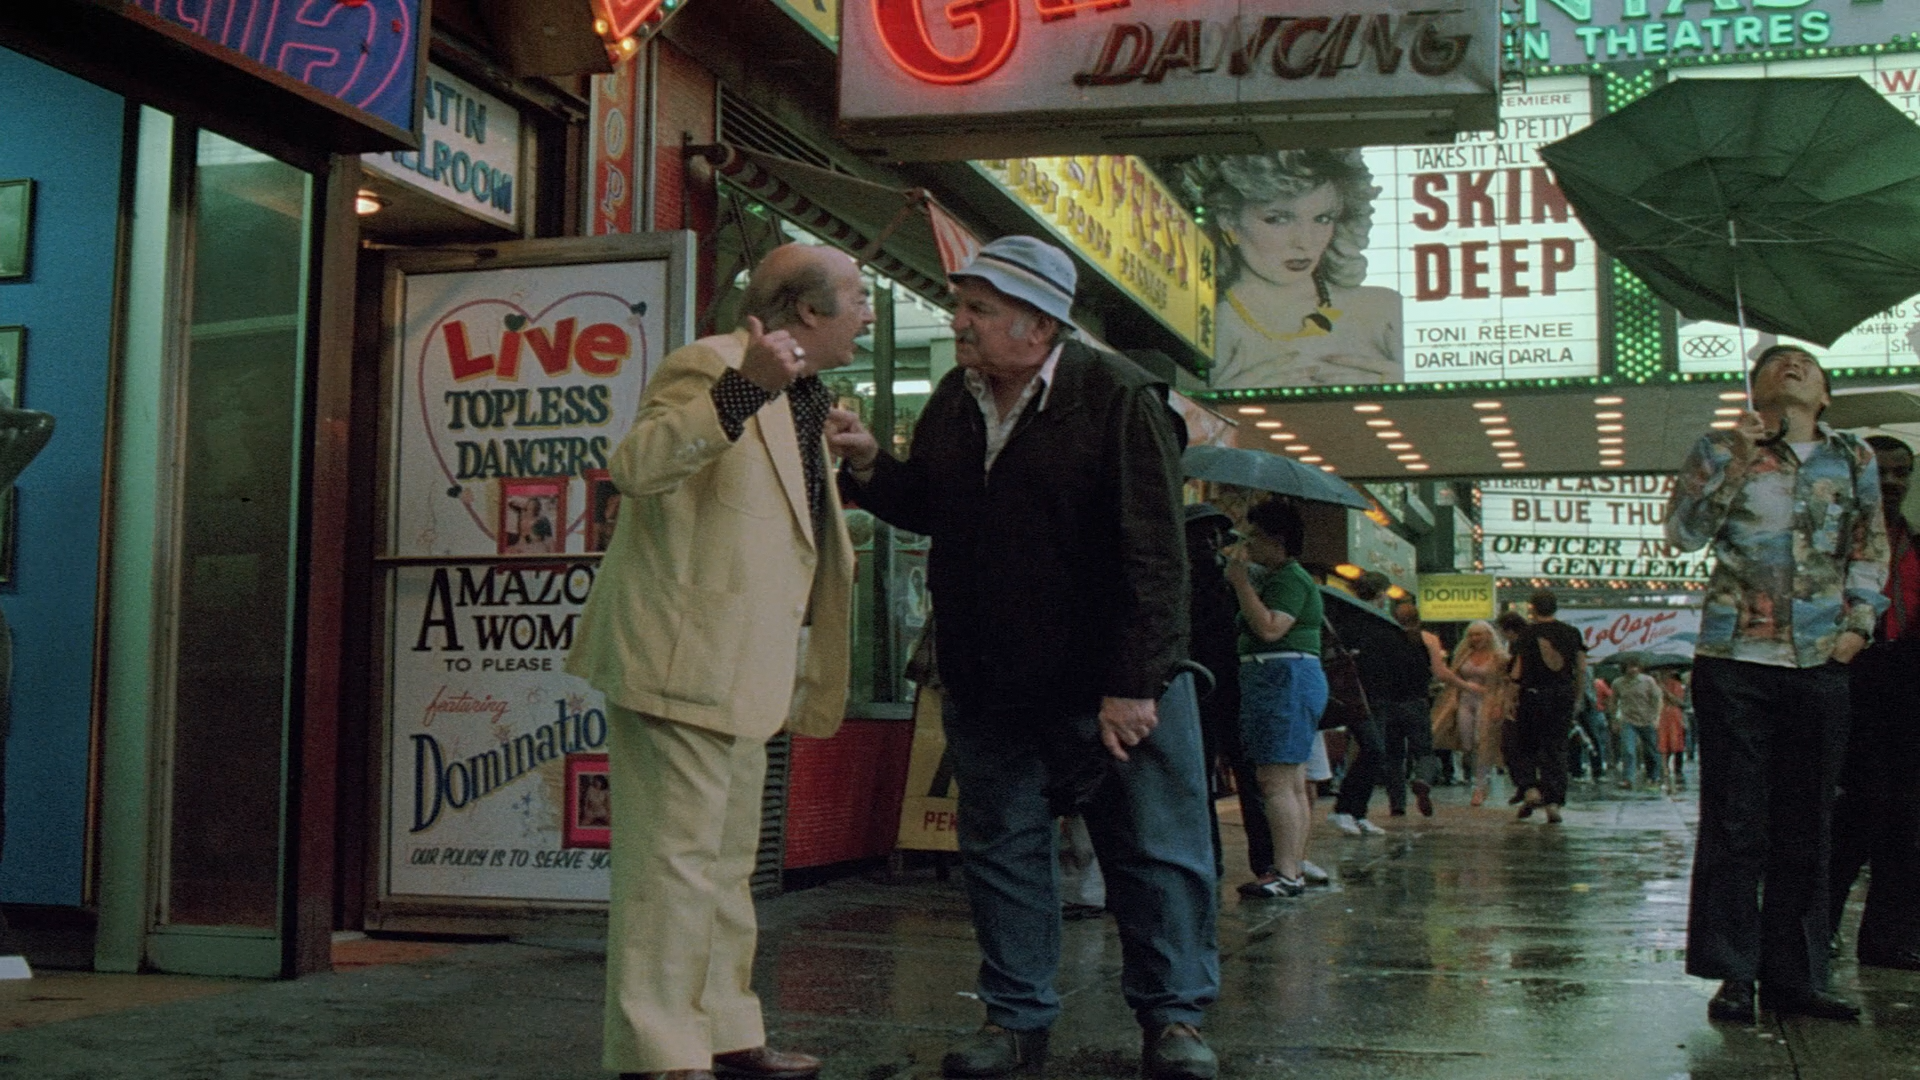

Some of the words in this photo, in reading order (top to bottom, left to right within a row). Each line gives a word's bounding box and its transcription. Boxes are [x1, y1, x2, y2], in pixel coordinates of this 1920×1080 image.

[1576, 10, 1832, 58] THEATRES
[1073, 12, 1472, 86] DANCING
[1515, 115, 1573, 139] PETTY
[1414, 148, 1467, 169] TAKES
[1472, 145, 1488, 166] IT
[1495, 142, 1530, 166] ALL
[1413, 167, 1568, 232] SKIN
[1414, 237, 1576, 302] DEEP
[1416, 327, 1466, 343] TONI
[1478, 322, 1573, 340] REENEE
[1415, 350, 1503, 368] DARLING
[1509, 347, 1573, 365] DARLA
[444, 384, 611, 430] TOPLESS
[455, 436, 608, 480] DANCERS
[1512, 499, 1592, 523] BLUE
[1493, 536, 1622, 556] OFFICER
[1542, 557, 1711, 578] GENTLEMA
[1423, 588, 1488, 602] DONUTS
[471, 613, 582, 651] WOM
[444, 658, 472, 672] TO
[482, 658, 552, 672] PLEASE
[424, 685, 509, 728] featuring
[410, 698, 607, 833] Dominatio
[411, 848, 438, 866] OUR
[440, 848, 487, 868] POLICY
[489, 849, 506, 868] IS
[509, 849, 529, 868] TO
[532, 850, 584, 870] SERVE
